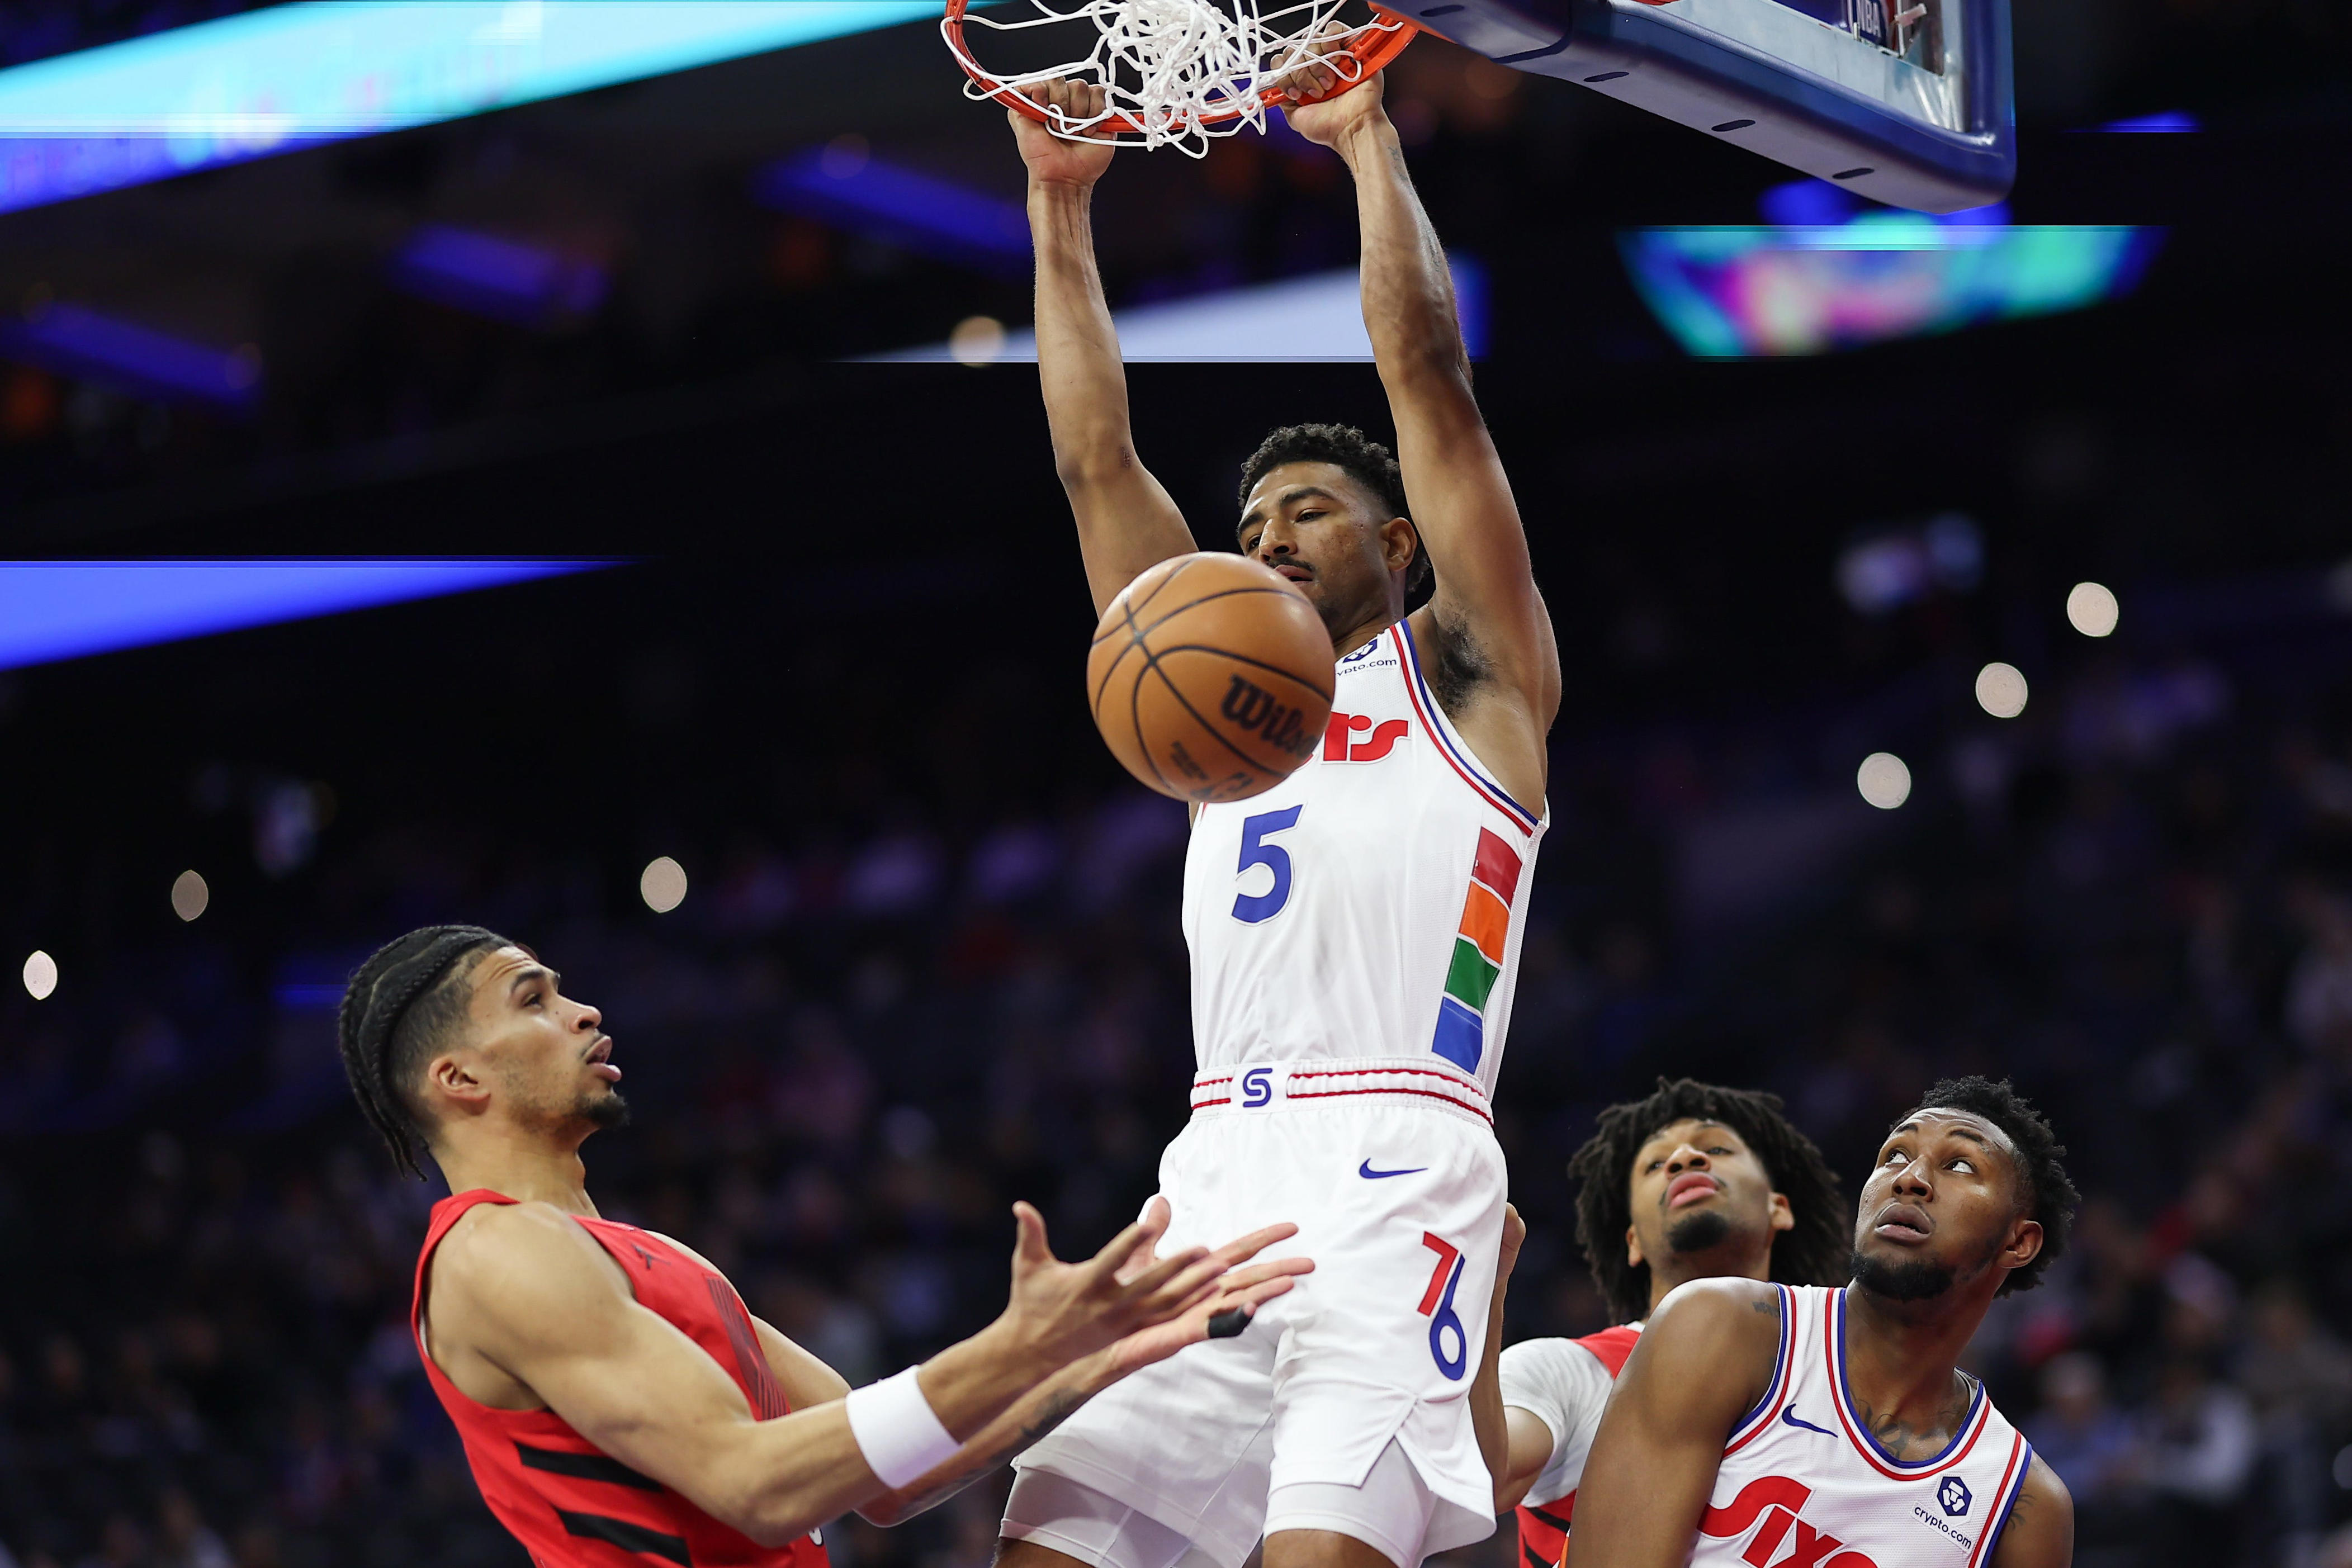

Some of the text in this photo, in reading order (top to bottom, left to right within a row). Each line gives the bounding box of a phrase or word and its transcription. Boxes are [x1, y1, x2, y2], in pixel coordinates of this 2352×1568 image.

[1856, 0, 1881, 38] NBA
[1337, 659, 1397, 676] ypto.com
[1222, 674, 1318, 759] Wils
[1231, 803, 1304, 924] 5
[1242, 1068, 1273, 1107] S
[1417, 1230, 1466, 1381] 76
[1696, 1475, 1880, 1568] Six
[1914, 1507, 1972, 1550] crypto.com
